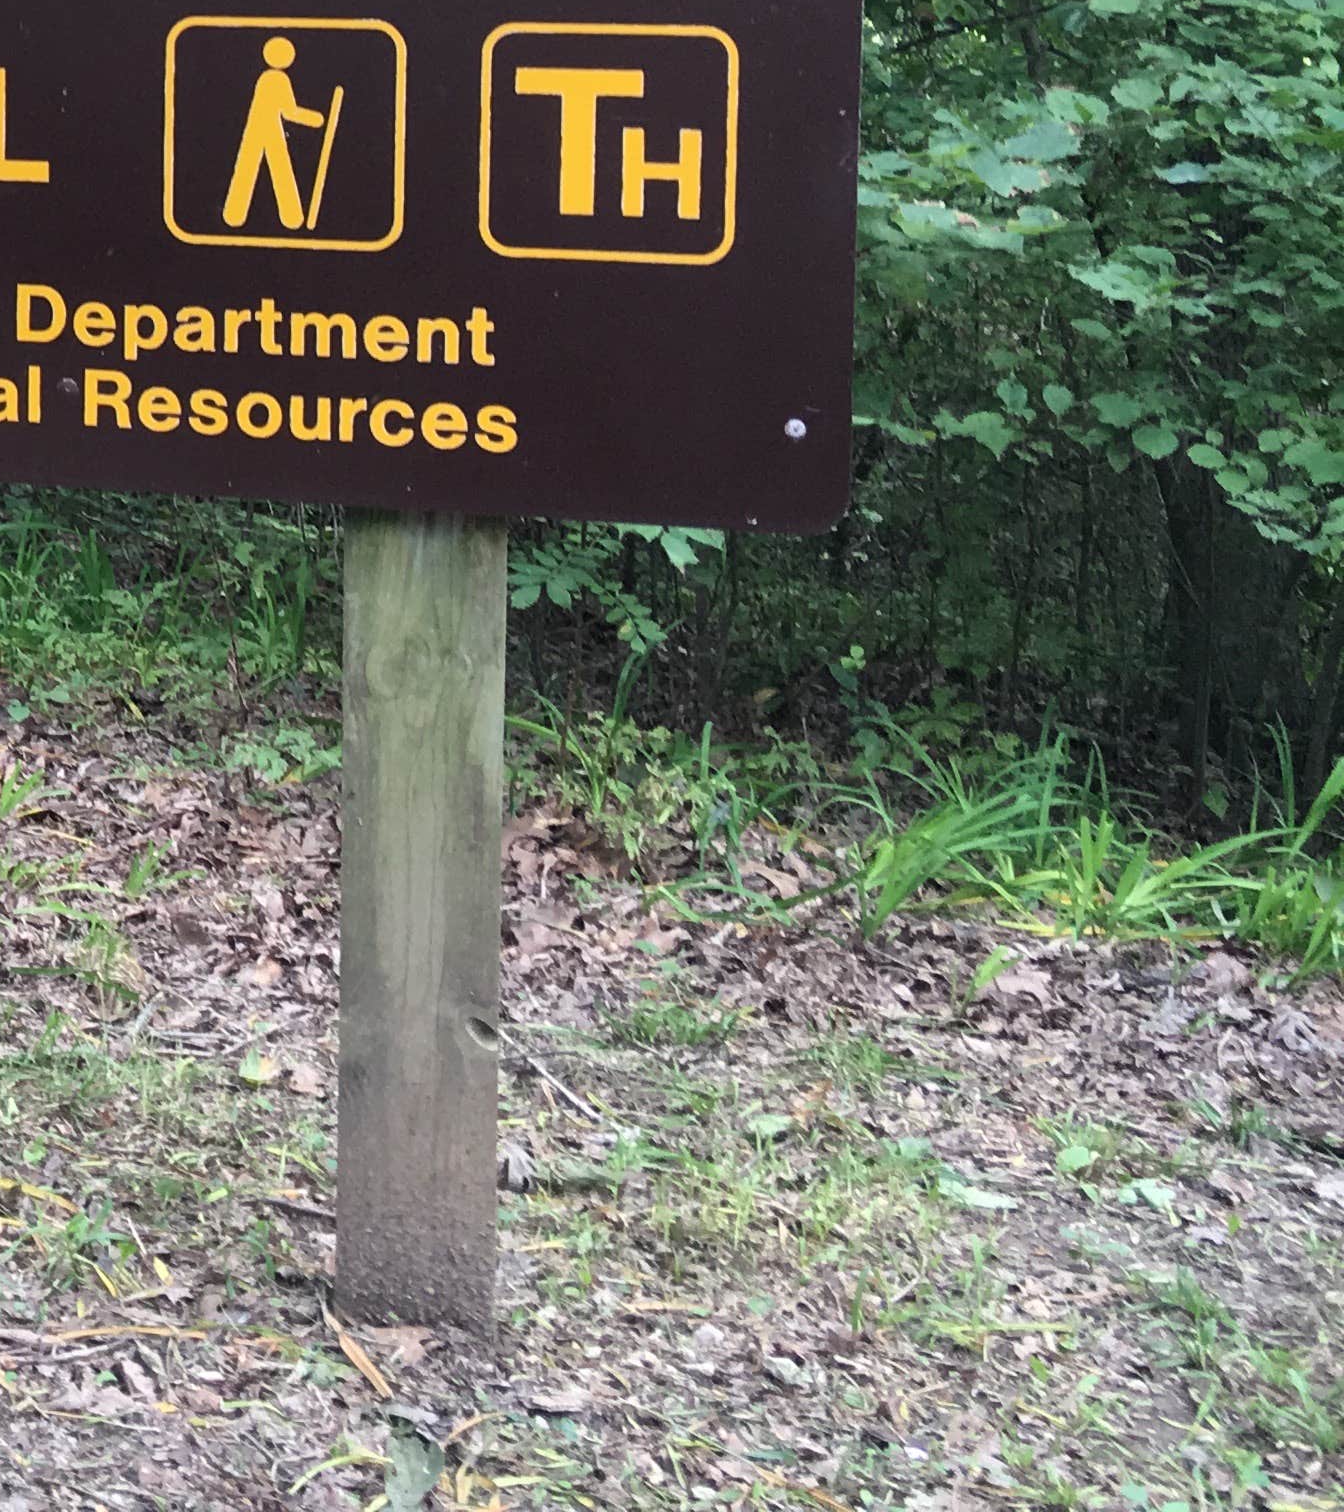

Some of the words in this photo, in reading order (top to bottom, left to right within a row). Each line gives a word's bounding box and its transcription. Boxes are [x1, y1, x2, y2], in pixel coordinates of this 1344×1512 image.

[514, 67, 703, 220] TH
[15, 282, 496, 368] Department
[82, 368, 519, 454] Resources
